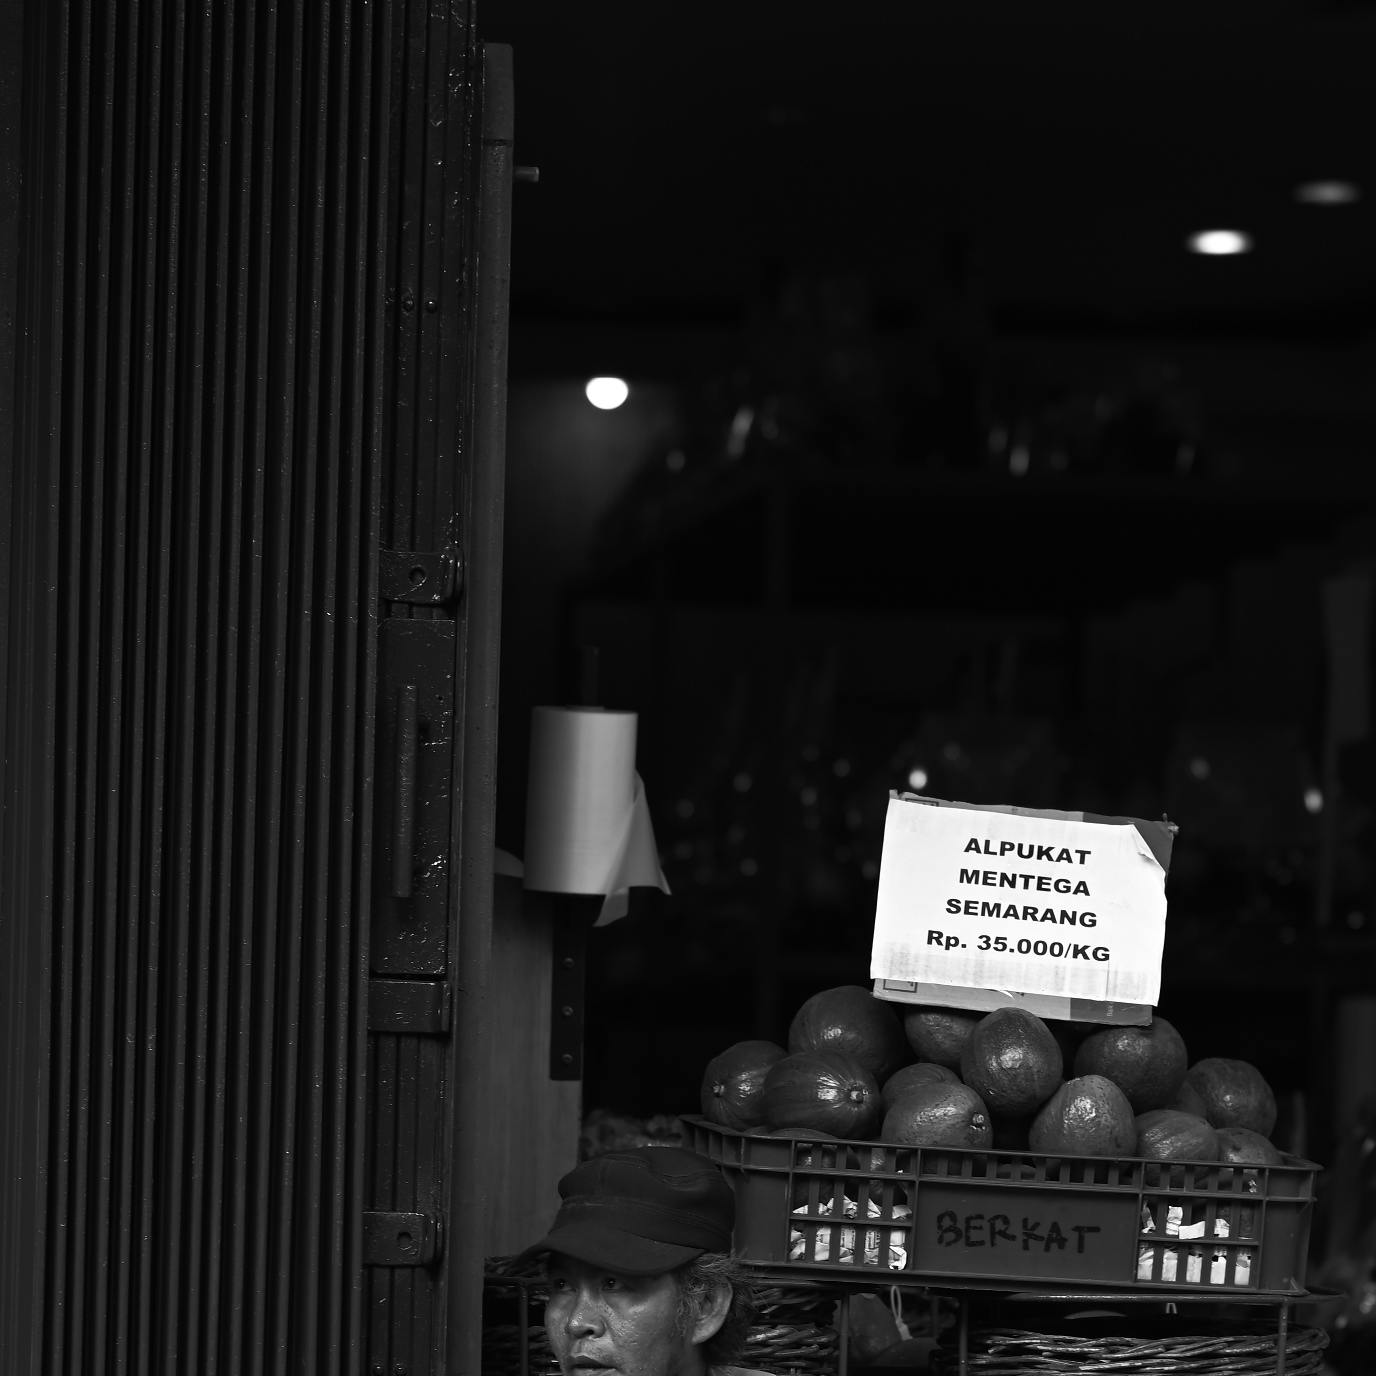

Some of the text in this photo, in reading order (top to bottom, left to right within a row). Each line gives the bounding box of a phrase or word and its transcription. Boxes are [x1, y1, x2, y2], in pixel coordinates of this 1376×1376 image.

[964, 838, 1091, 865] ALPUKAT
[959, 868, 1091, 897] MENTEGA
[945, 898, 1098, 928] SEMARANG
[927, 930, 1111, 963] Rp. 35.000/KG
[936, 1210, 1101, 1255] BERKAT
